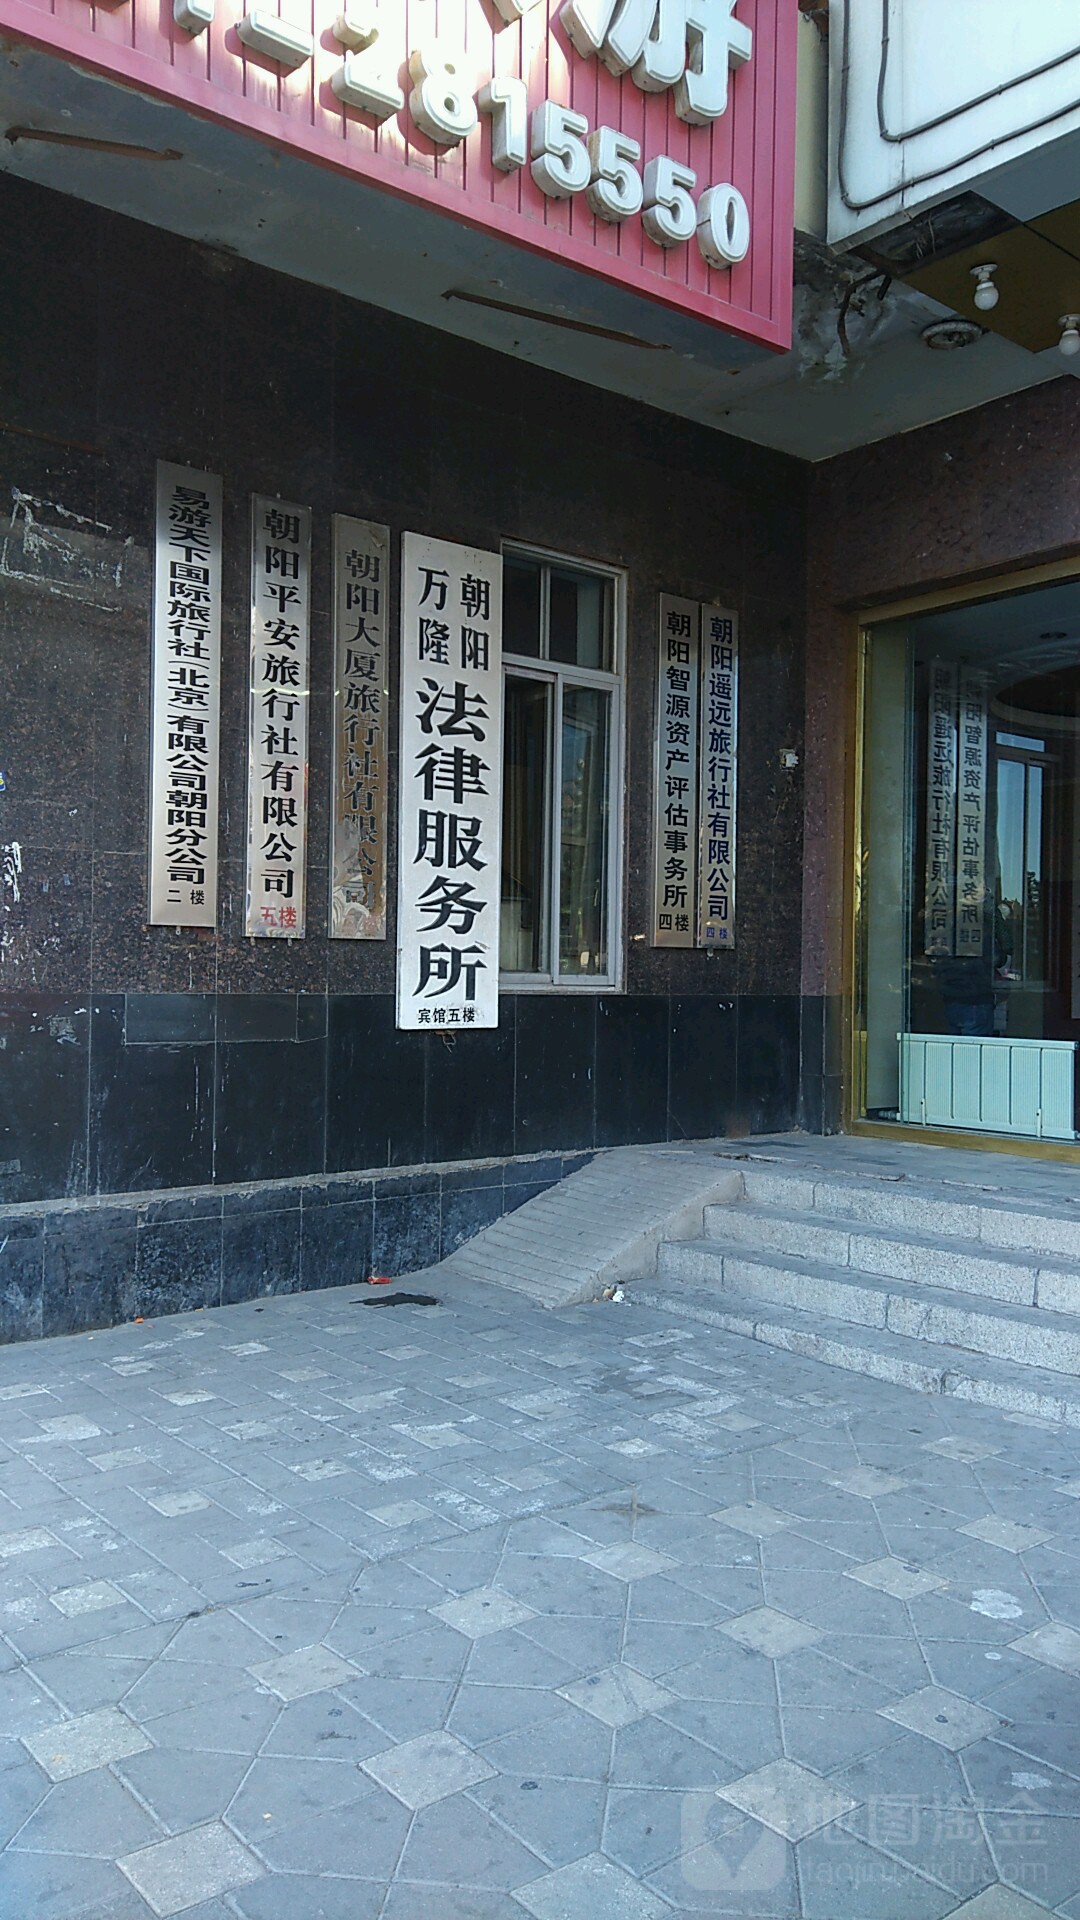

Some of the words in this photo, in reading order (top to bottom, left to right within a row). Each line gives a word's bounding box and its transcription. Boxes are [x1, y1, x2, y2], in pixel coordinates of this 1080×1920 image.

[418, 567, 450, 665] 万隆
[460, 573, 491, 671] 朝阳
[260, 508, 302, 898] 朝阳平安旅行社有限公司
[343, 549, 381, 912] 朝阳大厦旅行社有限公司
[663, 611, 691, 908] 朝阳智源资产评估事务所
[707, 617, 733, 920] 朝阳遥远旅行社有限公司
[413, 677, 492, 1000] 法律服务所
[167, 889, 205, 905] 二楼
[260, 906, 297, 928] 五楼
[659, 914, 689, 931] 四楼
[706, 927, 728, 939] 四楼
[418, 1007, 475, 1023] 宾馆五楼
